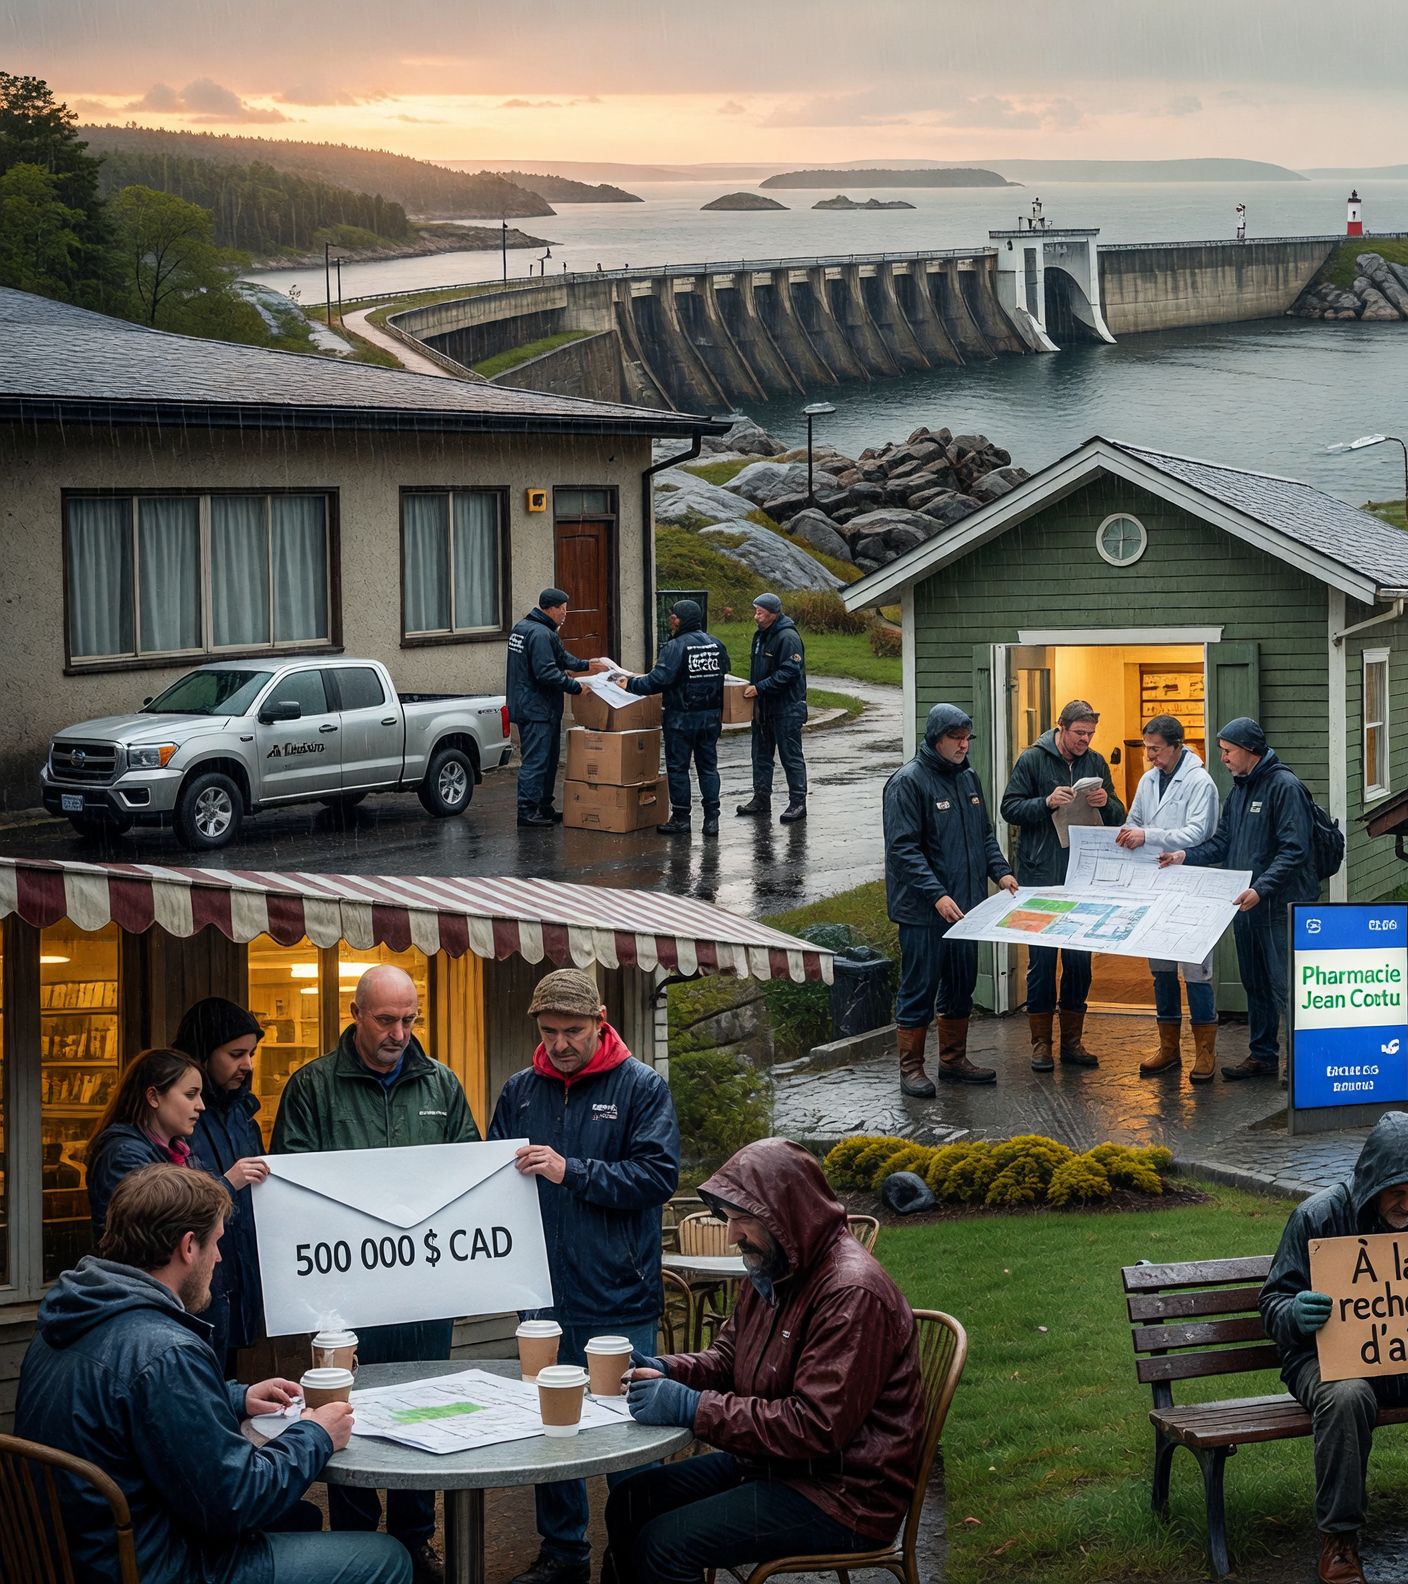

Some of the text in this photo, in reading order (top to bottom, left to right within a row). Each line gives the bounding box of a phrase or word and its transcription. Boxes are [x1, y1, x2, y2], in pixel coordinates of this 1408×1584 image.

[1302, 963, 1401, 986] Pharmacie
[1301, 990, 1346, 1010] Jean
[296, 1226, 513, 1276] 500 000 $ CAD
[1352, 1238, 1378, 1284] À
